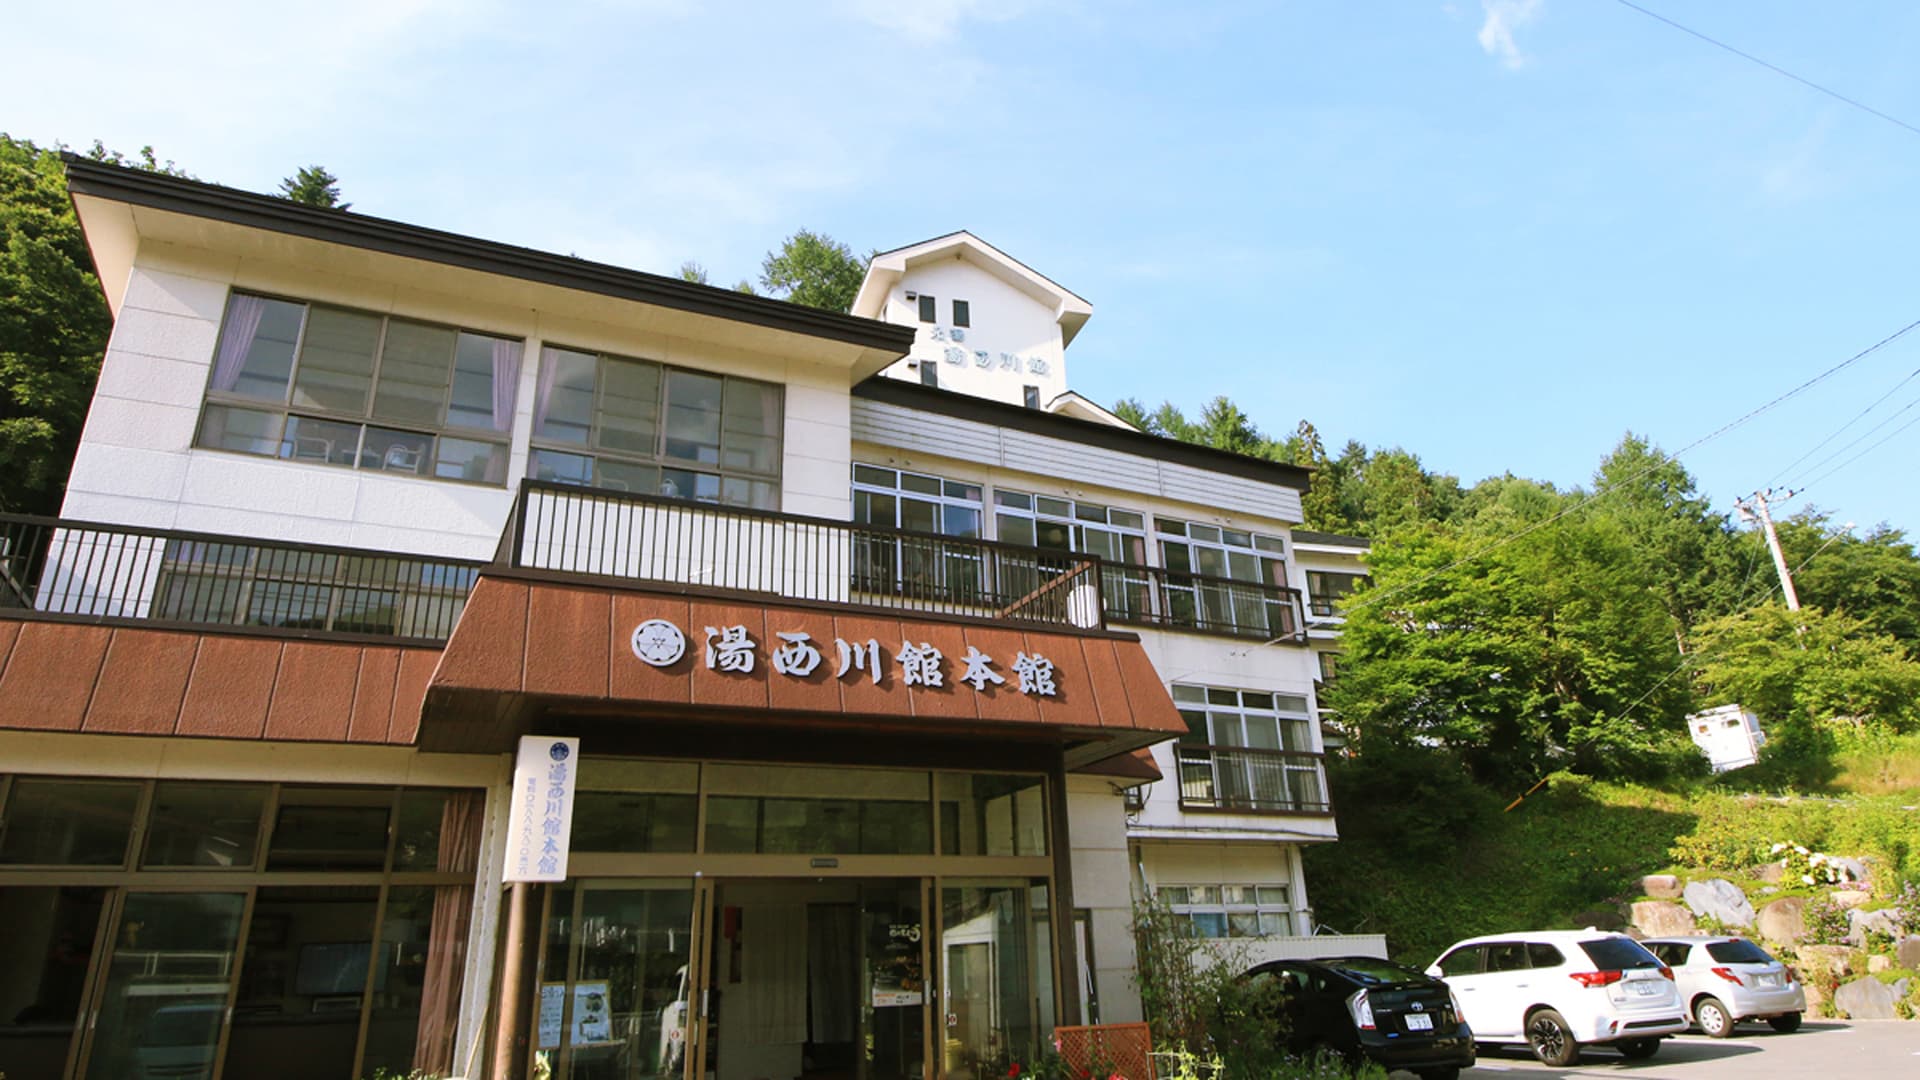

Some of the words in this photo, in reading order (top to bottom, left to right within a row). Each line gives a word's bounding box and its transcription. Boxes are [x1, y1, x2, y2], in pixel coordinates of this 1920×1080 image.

[704, 625, 1056, 696] 湯西川館本館
[538, 763, 567, 874] 湯西川館本館
